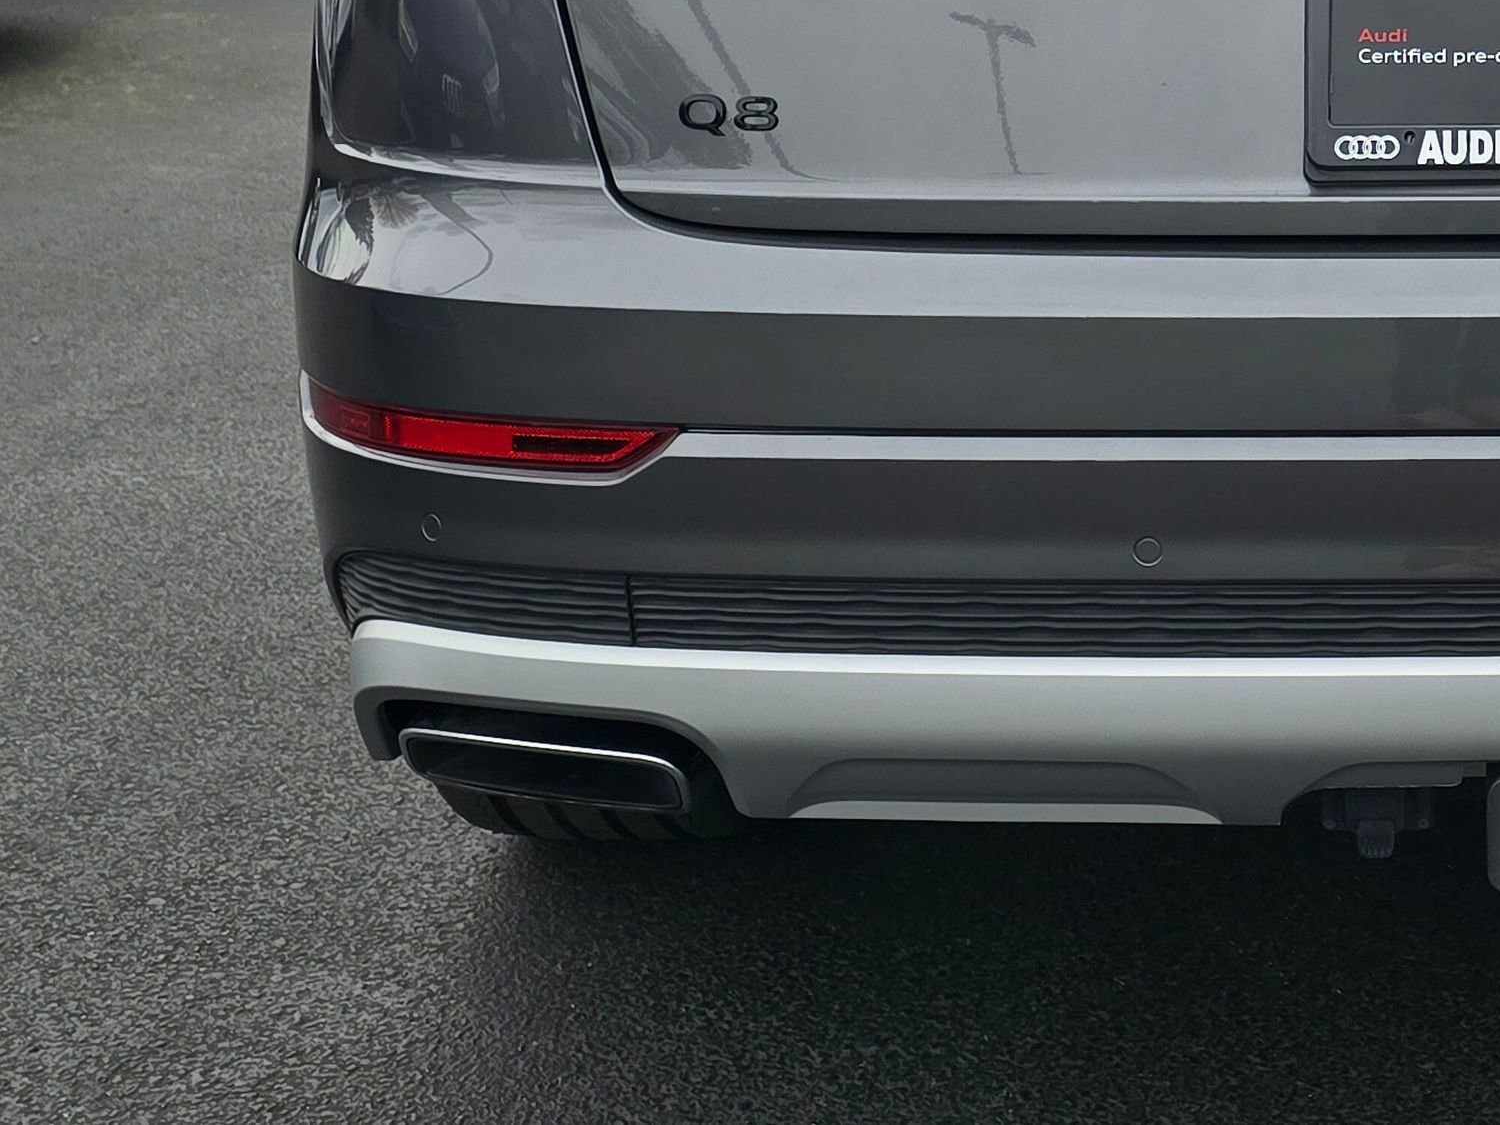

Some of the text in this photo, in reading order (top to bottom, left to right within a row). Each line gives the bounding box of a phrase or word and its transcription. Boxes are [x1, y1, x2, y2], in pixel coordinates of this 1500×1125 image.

[1358, 28, 1408, 43] Audi
[1358, 48, 1448, 64] Certified
[678, 94, 779, 137] Q8
